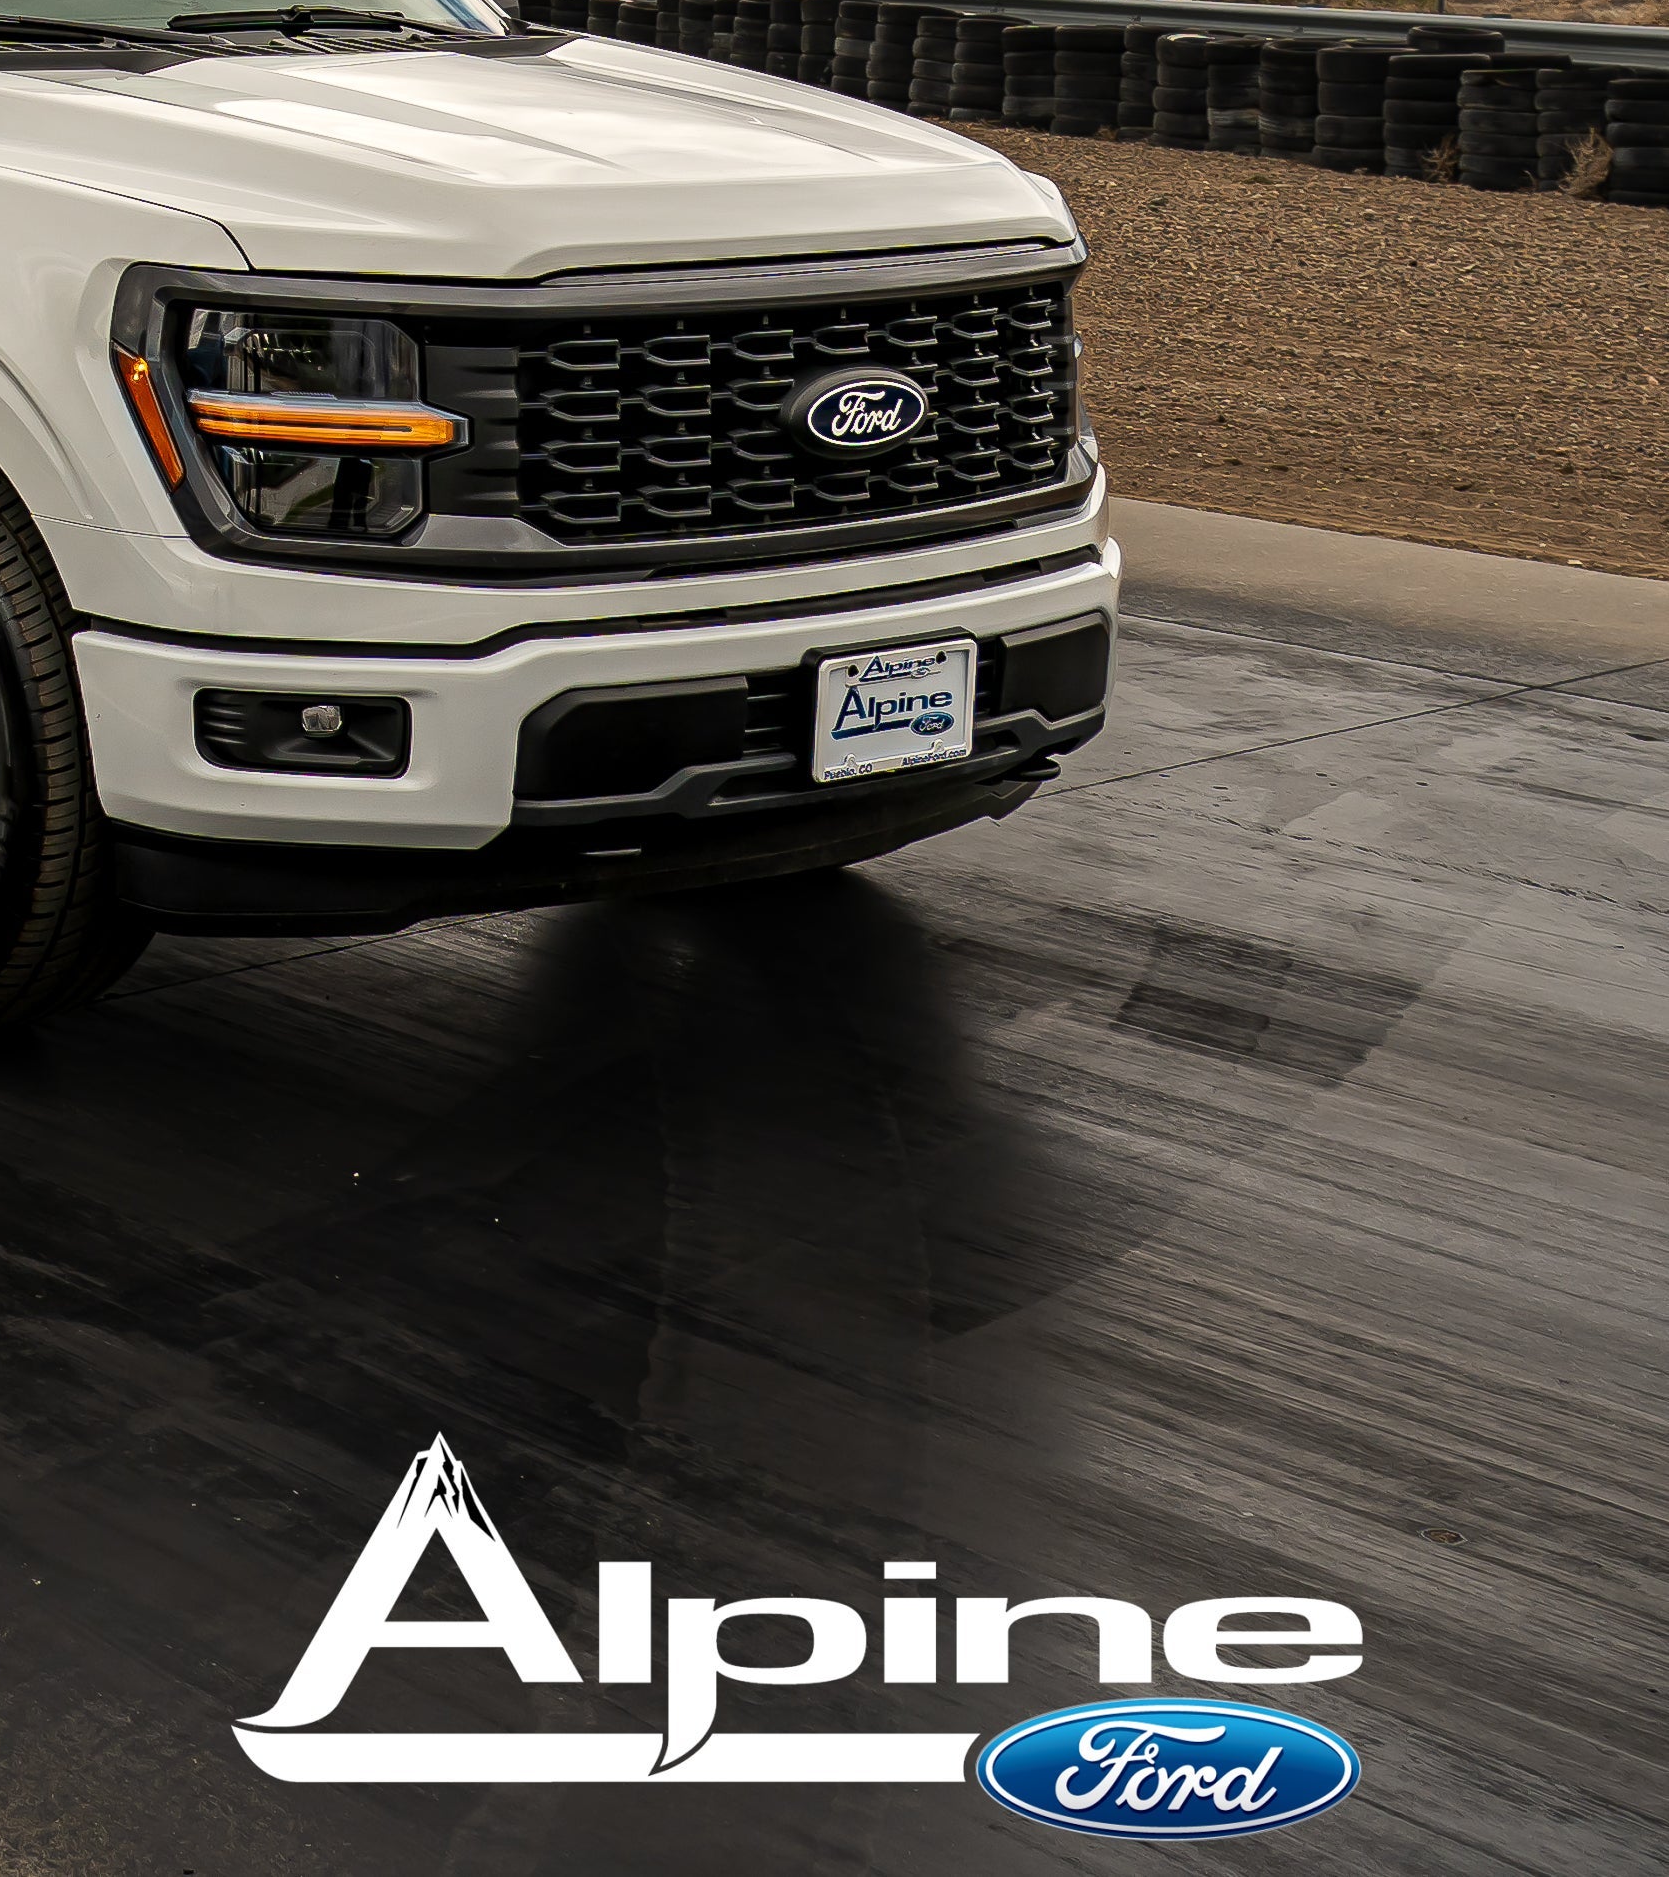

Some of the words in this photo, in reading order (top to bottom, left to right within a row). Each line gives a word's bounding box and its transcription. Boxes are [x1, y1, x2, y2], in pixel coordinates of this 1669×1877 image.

[831, 390, 902, 435] Ford
[859, 655, 936, 679] Alpine
[831, 686, 953, 731] Alpine
[920, 715, 946, 731] Ford
